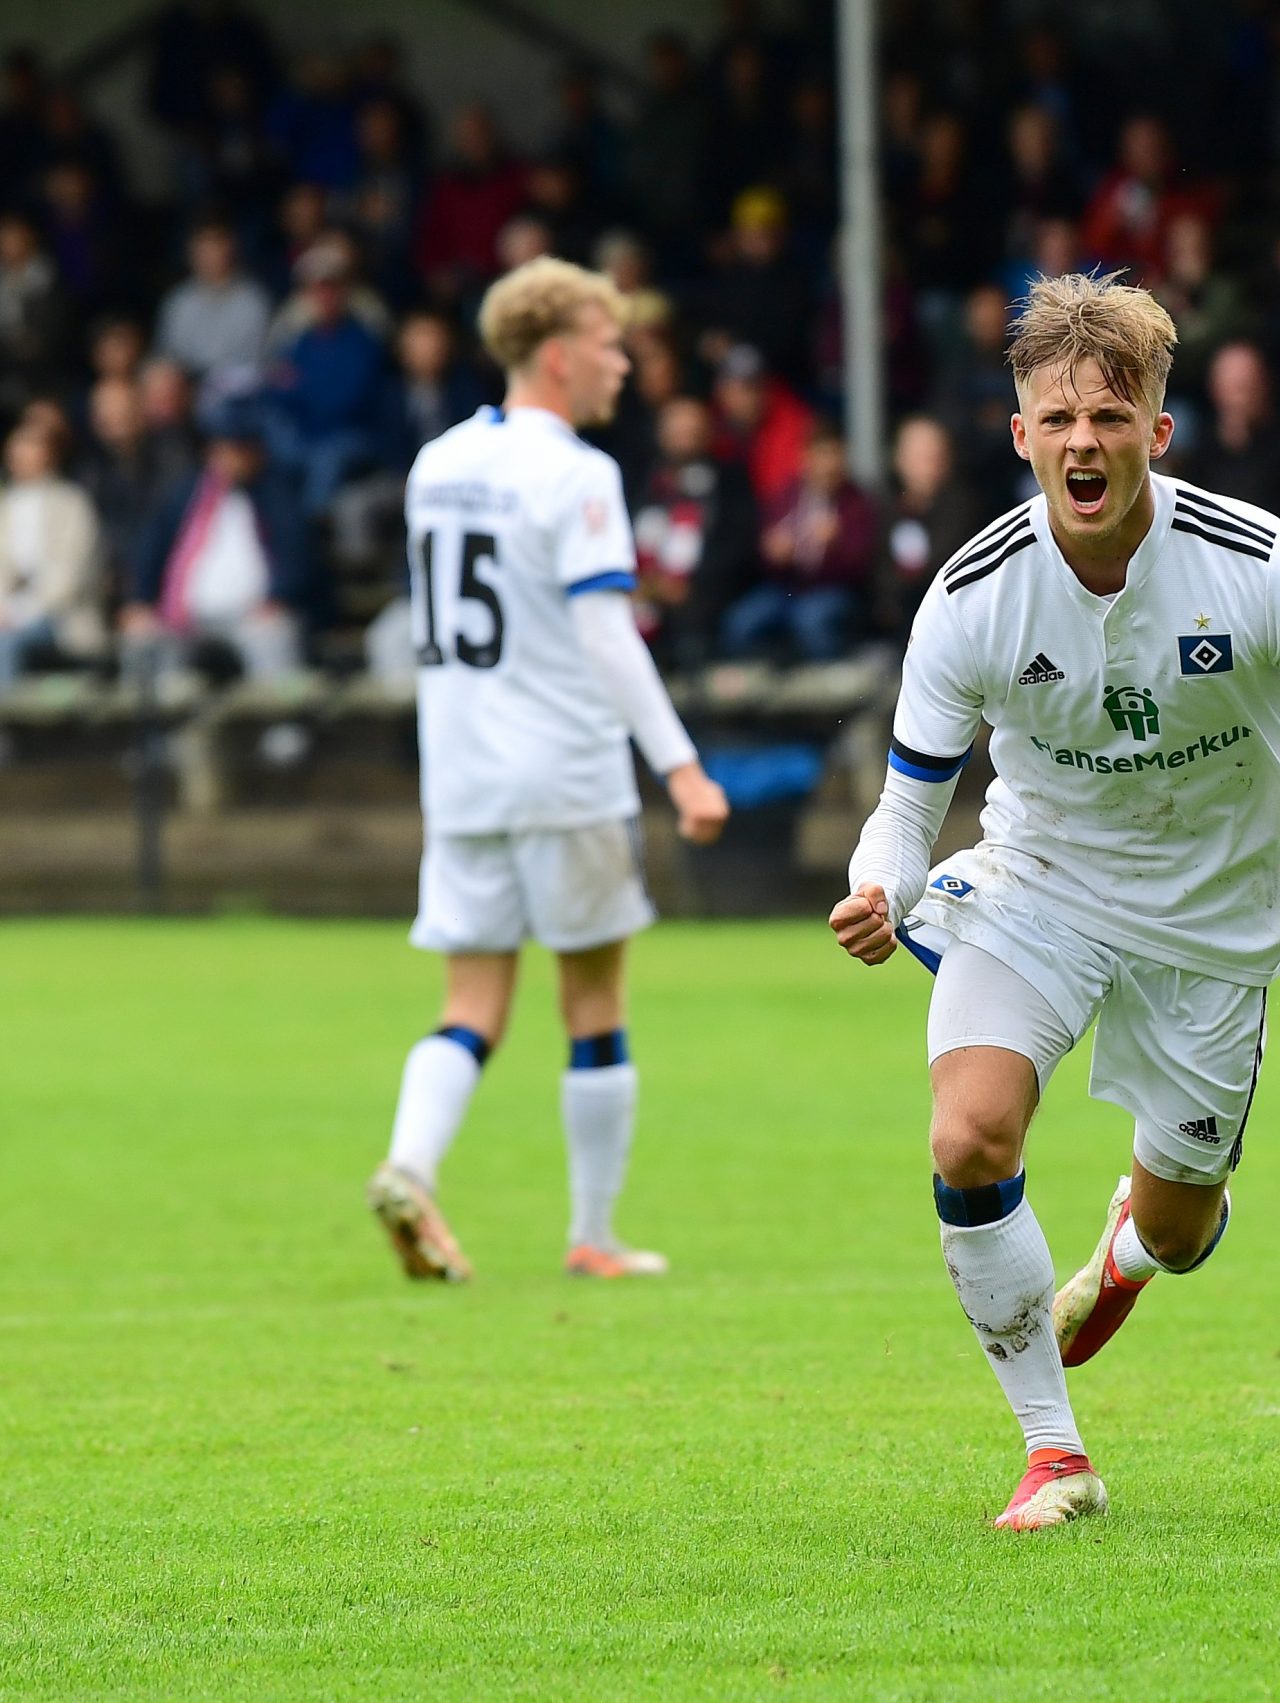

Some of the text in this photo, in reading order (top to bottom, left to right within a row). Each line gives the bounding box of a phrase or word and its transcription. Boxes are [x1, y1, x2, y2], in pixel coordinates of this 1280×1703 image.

[418, 528, 504, 668] 15
[1018, 670, 1065, 685] adidas
[1178, 1123, 1220, 1144] adidas
